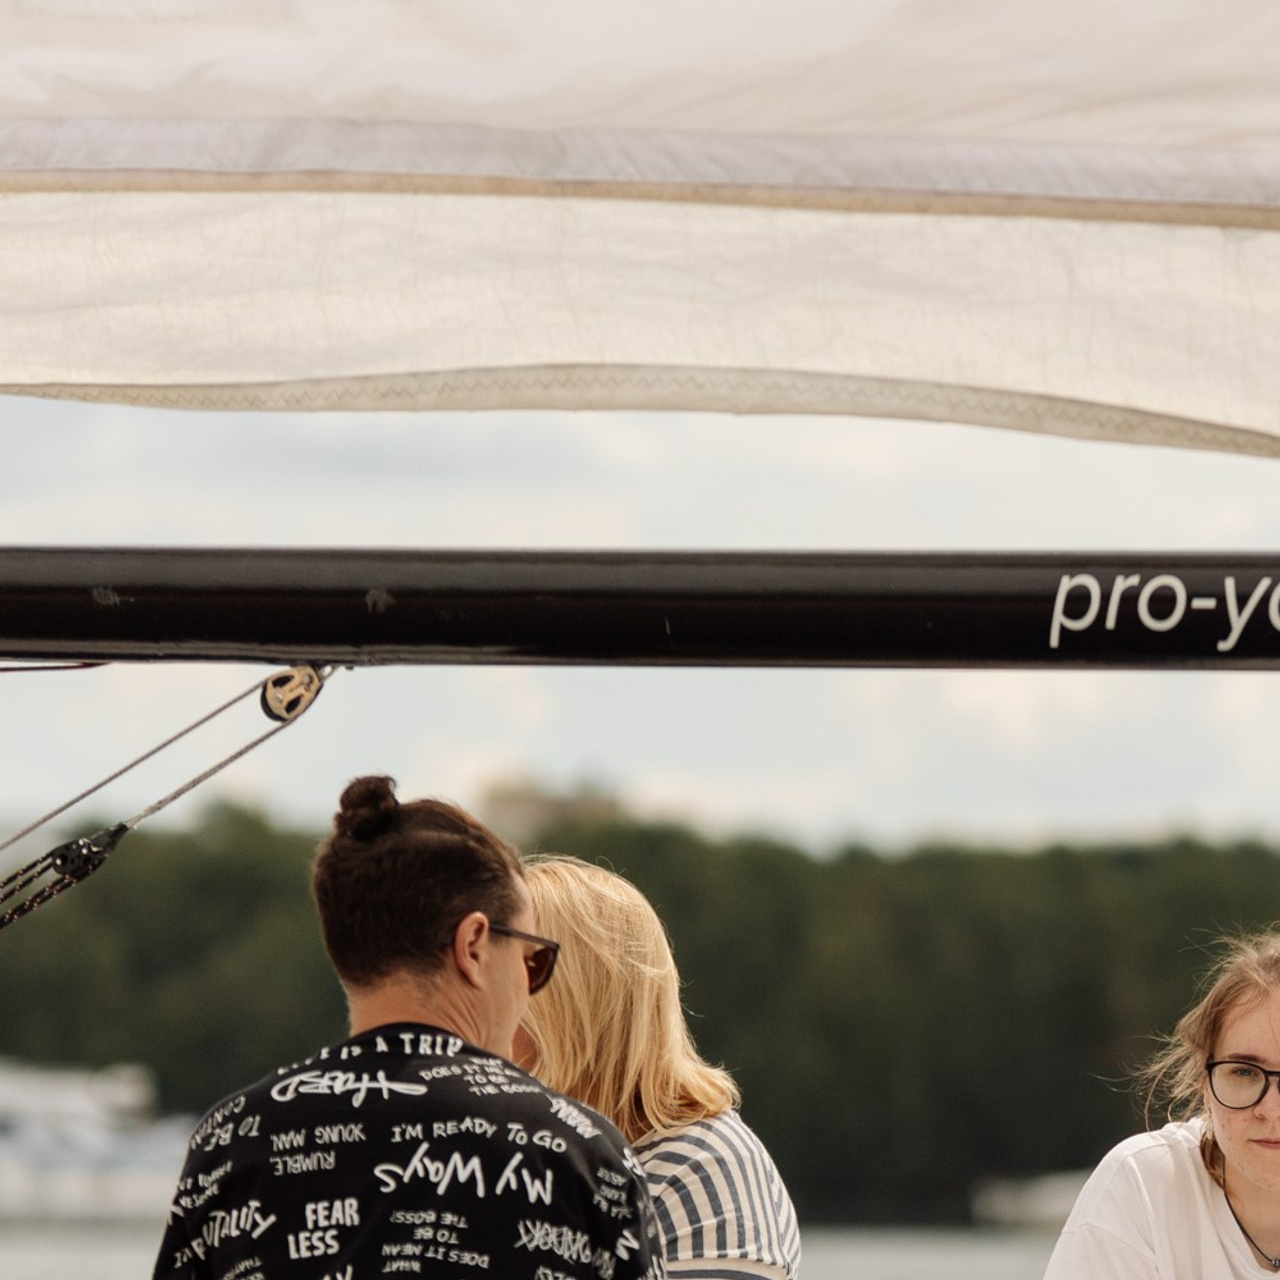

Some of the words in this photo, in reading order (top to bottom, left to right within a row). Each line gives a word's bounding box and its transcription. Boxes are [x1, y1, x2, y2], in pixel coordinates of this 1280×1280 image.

[375, 1036, 389, 1053] A
[399, 1033, 464, 1057] TRIP
[432, 1115, 498, 1139] READY
[532, 1129, 567, 1153] GO
[305, 1197, 360, 1230] FEAR
[287, 1229, 340, 1259] LESS
[436, 1228, 460, 1244] TO
[447, 1249, 490, 1270] DOES
